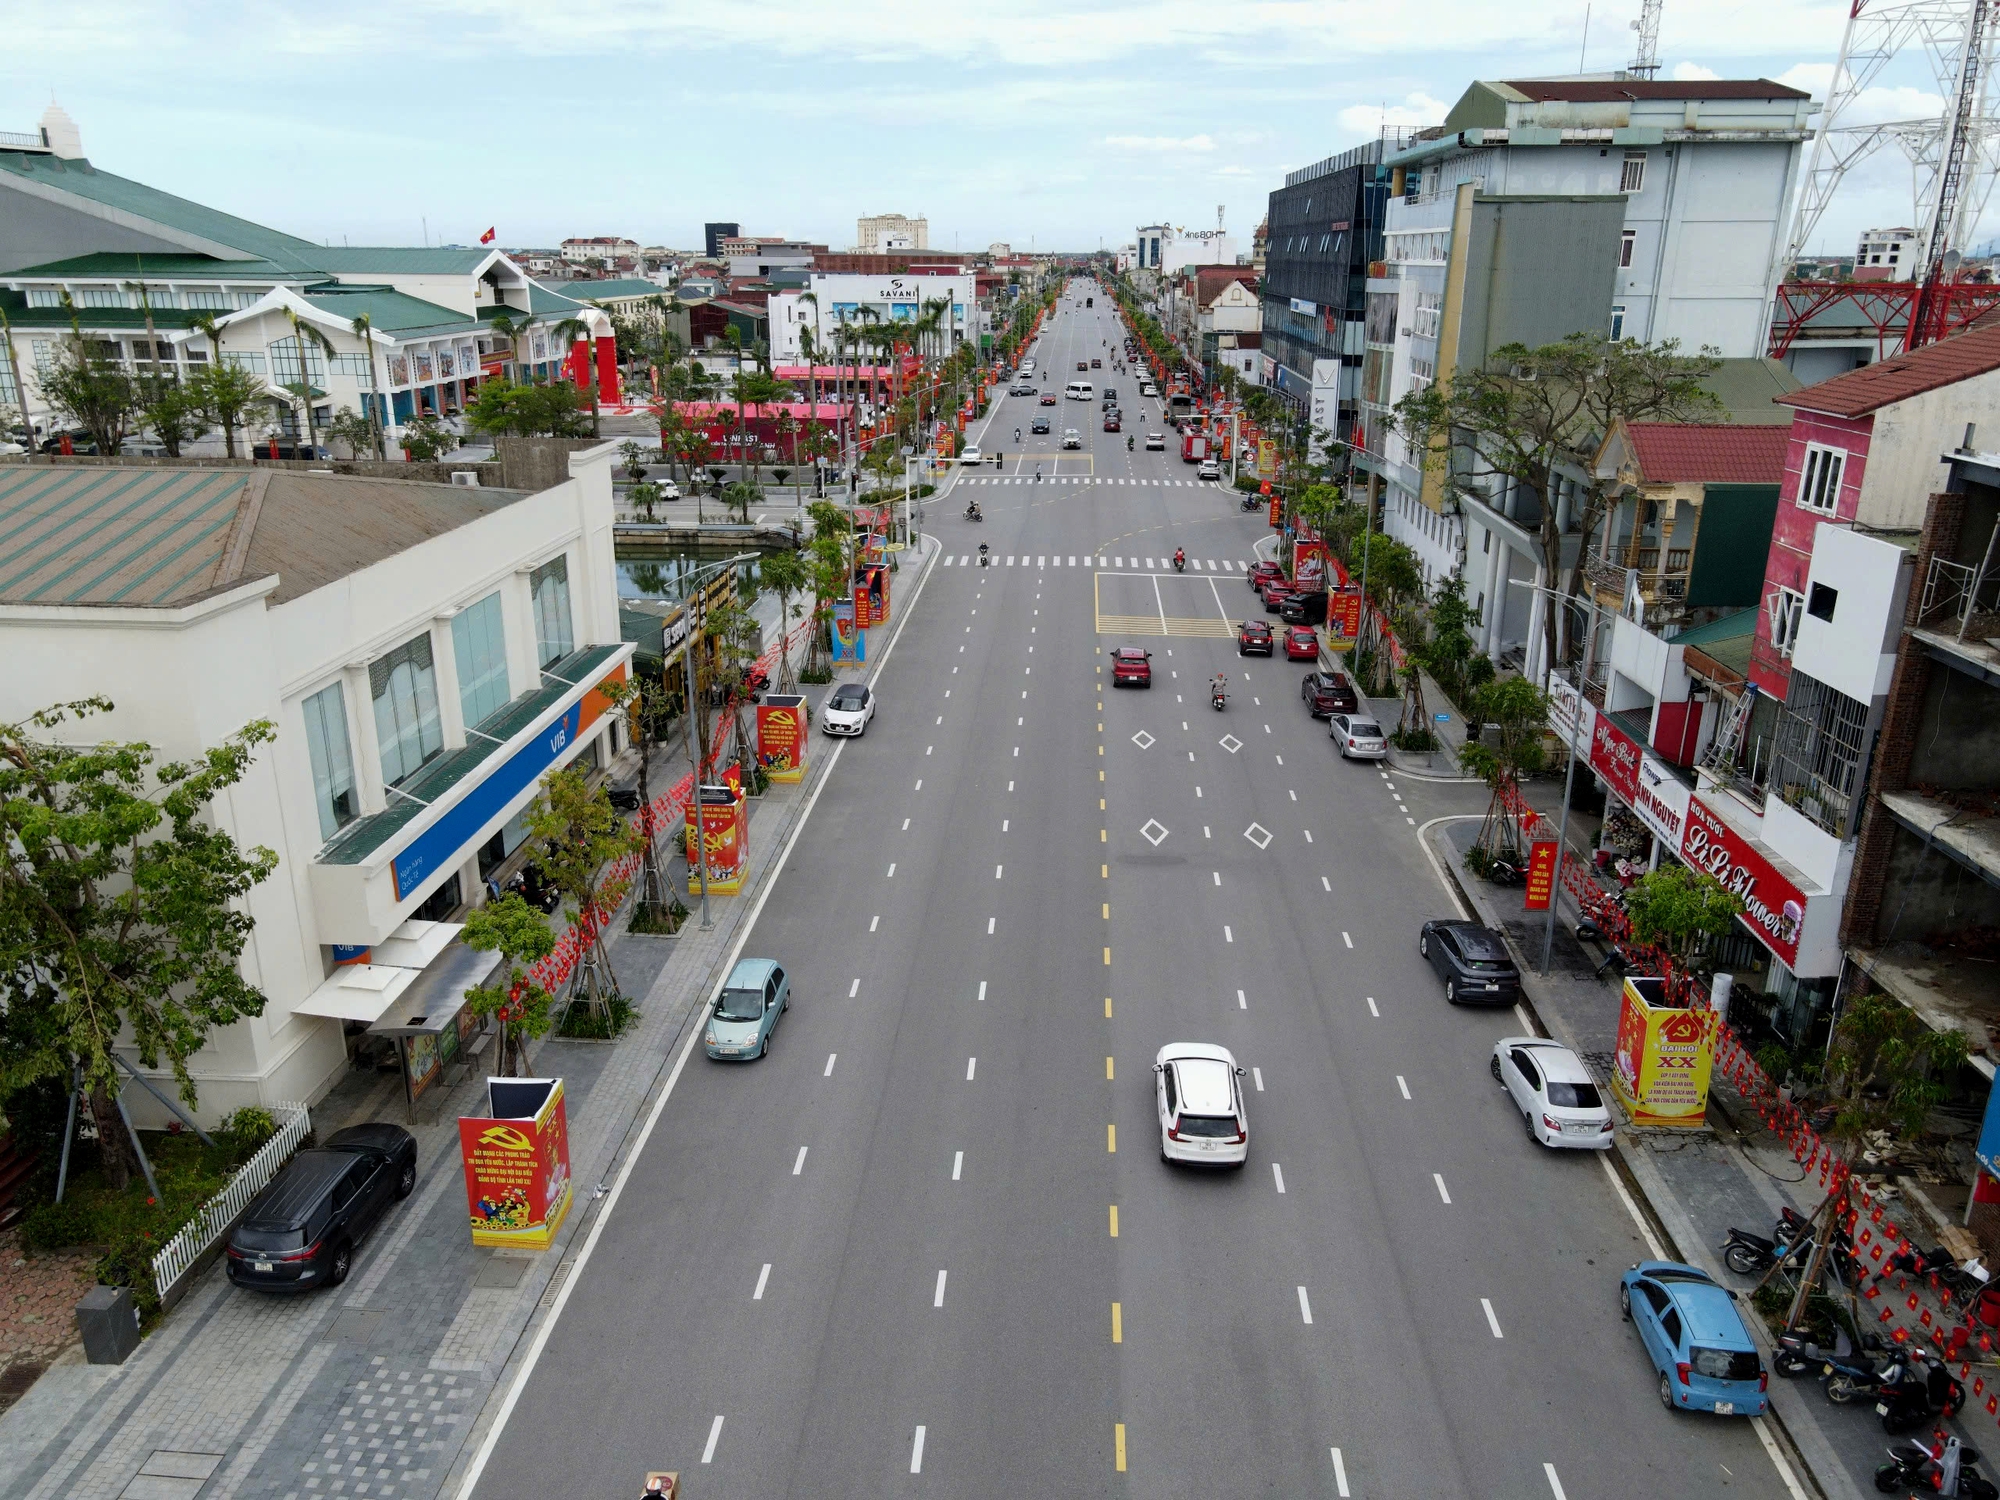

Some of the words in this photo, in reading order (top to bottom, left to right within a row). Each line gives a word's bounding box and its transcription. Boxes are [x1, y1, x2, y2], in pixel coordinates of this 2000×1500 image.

[550, 730, 566, 753] VIB
[1690, 802, 1705, 822] HOA
[1660, 1044, 1680, 1053] ĐẠI
[1680, 1044, 1698, 1053] HỘI
[1656, 1056, 1697, 1068] XX
